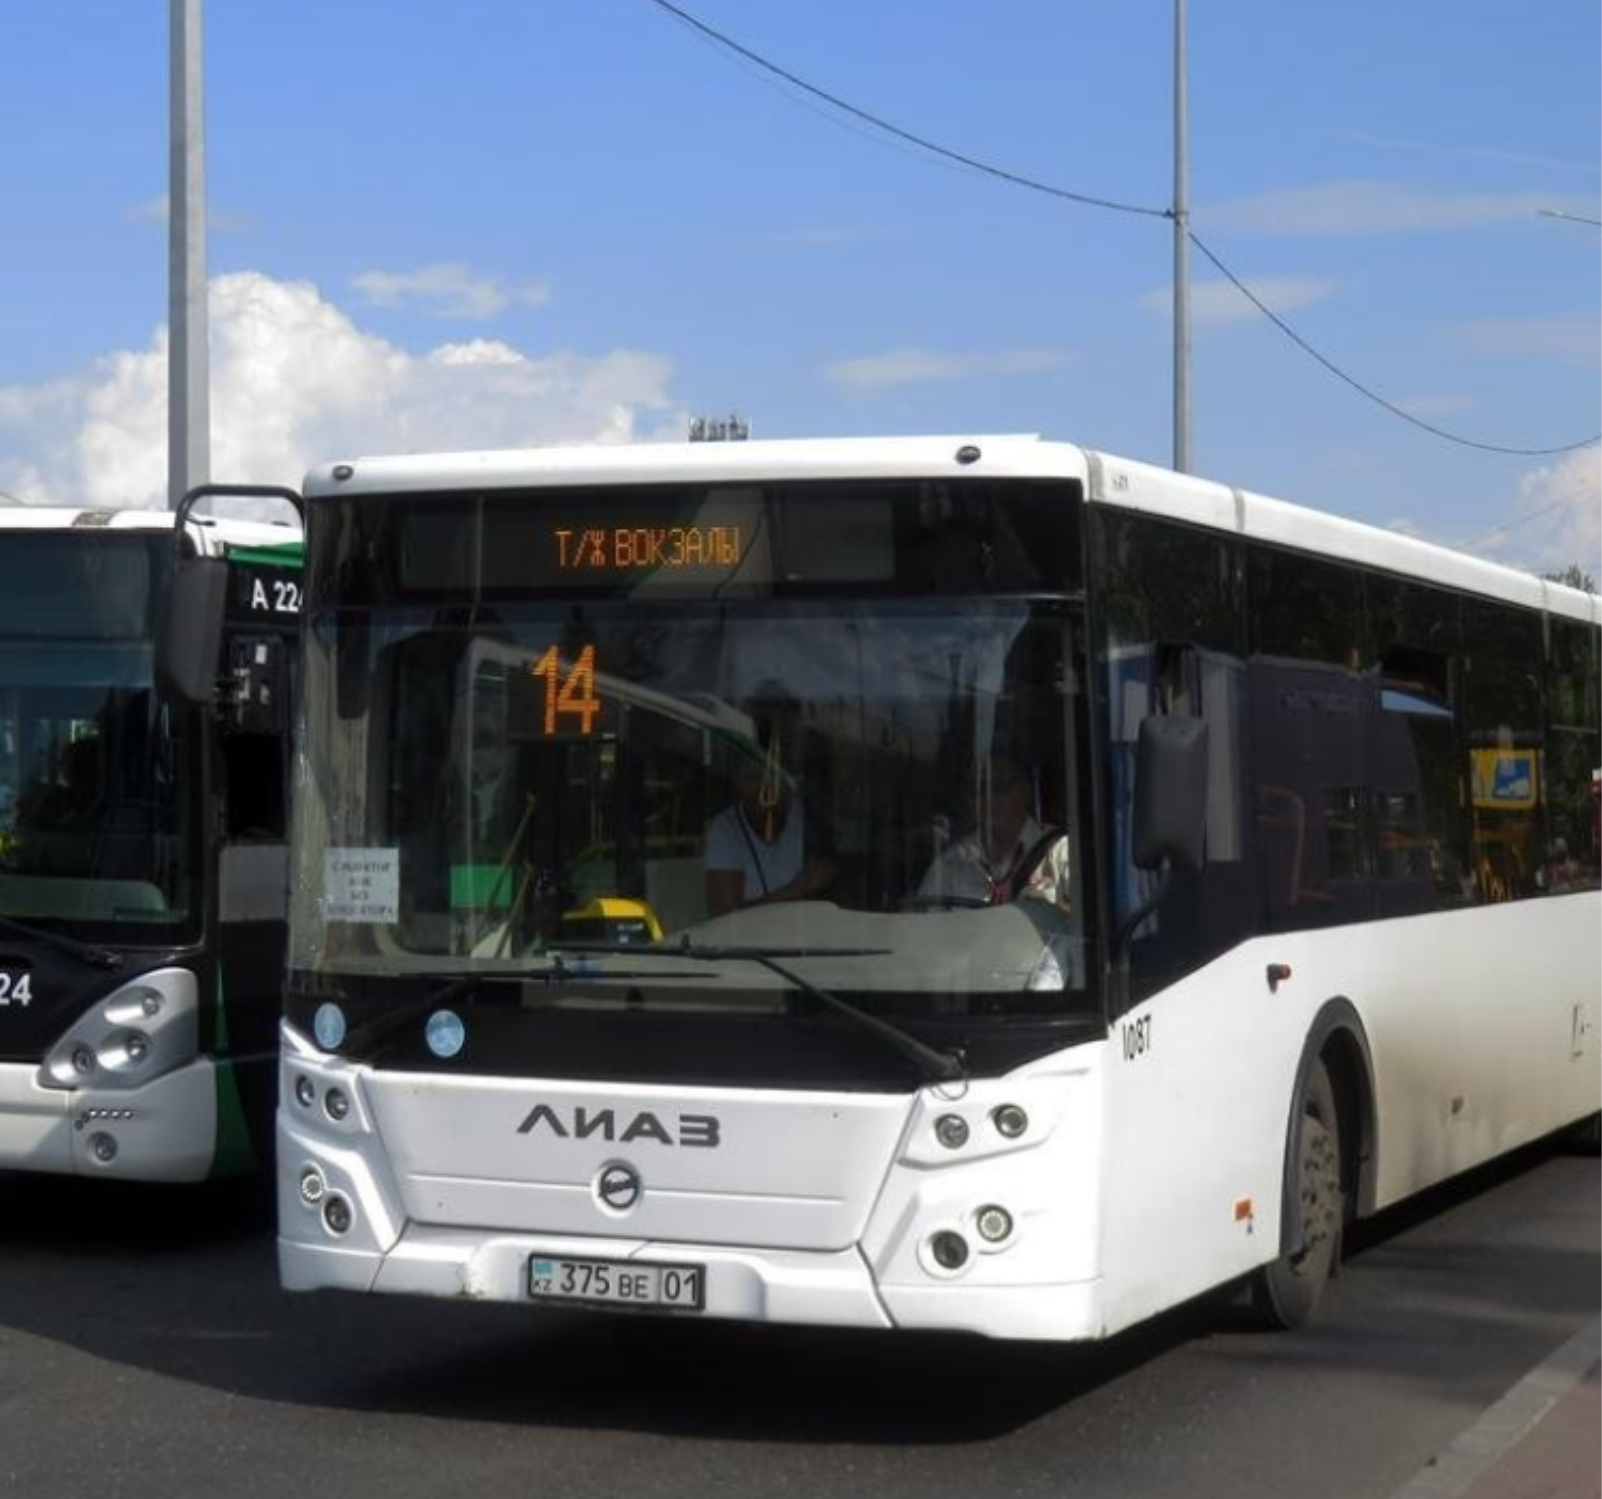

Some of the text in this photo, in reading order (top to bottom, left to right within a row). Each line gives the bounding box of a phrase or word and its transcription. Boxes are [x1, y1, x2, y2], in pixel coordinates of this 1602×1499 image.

[615, 527, 739, 566] ВОКЗАЛЫ
[532, 645, 600, 735] 14
[0, 973, 33, 1006] 24
[516, 1104, 720, 1148] ЛИАЗ
[560, 1262, 610, 1296] 375
[618, 1274, 649, 1299] BE
[664, 1270, 697, 1303] 01
